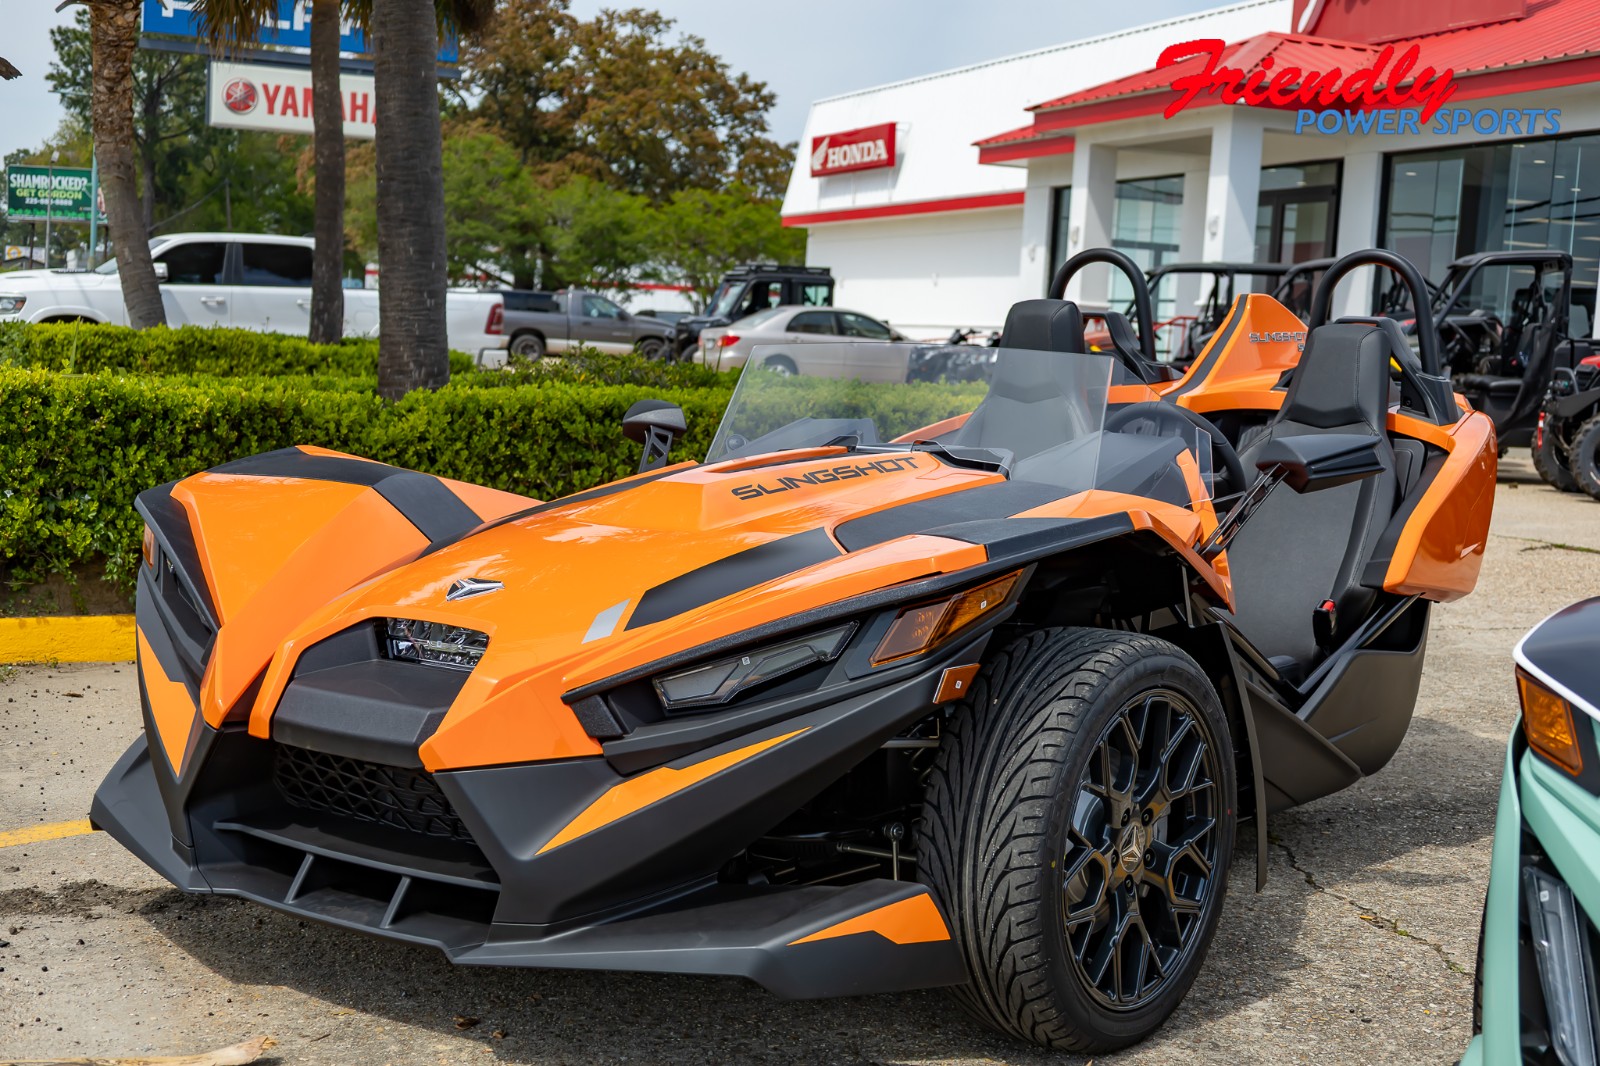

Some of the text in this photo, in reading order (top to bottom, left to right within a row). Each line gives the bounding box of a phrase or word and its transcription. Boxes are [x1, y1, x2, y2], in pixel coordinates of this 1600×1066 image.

[262, 83, 377, 125] YAH
[827, 138, 889, 170] HONDA
[9, 173, 88, 192] SHAMROCKED?
[16, 188, 82, 200] GET GORDON
[1249, 331, 1307, 343] SLINGSHOT
[731, 456, 919, 501] SLINGSHOT
